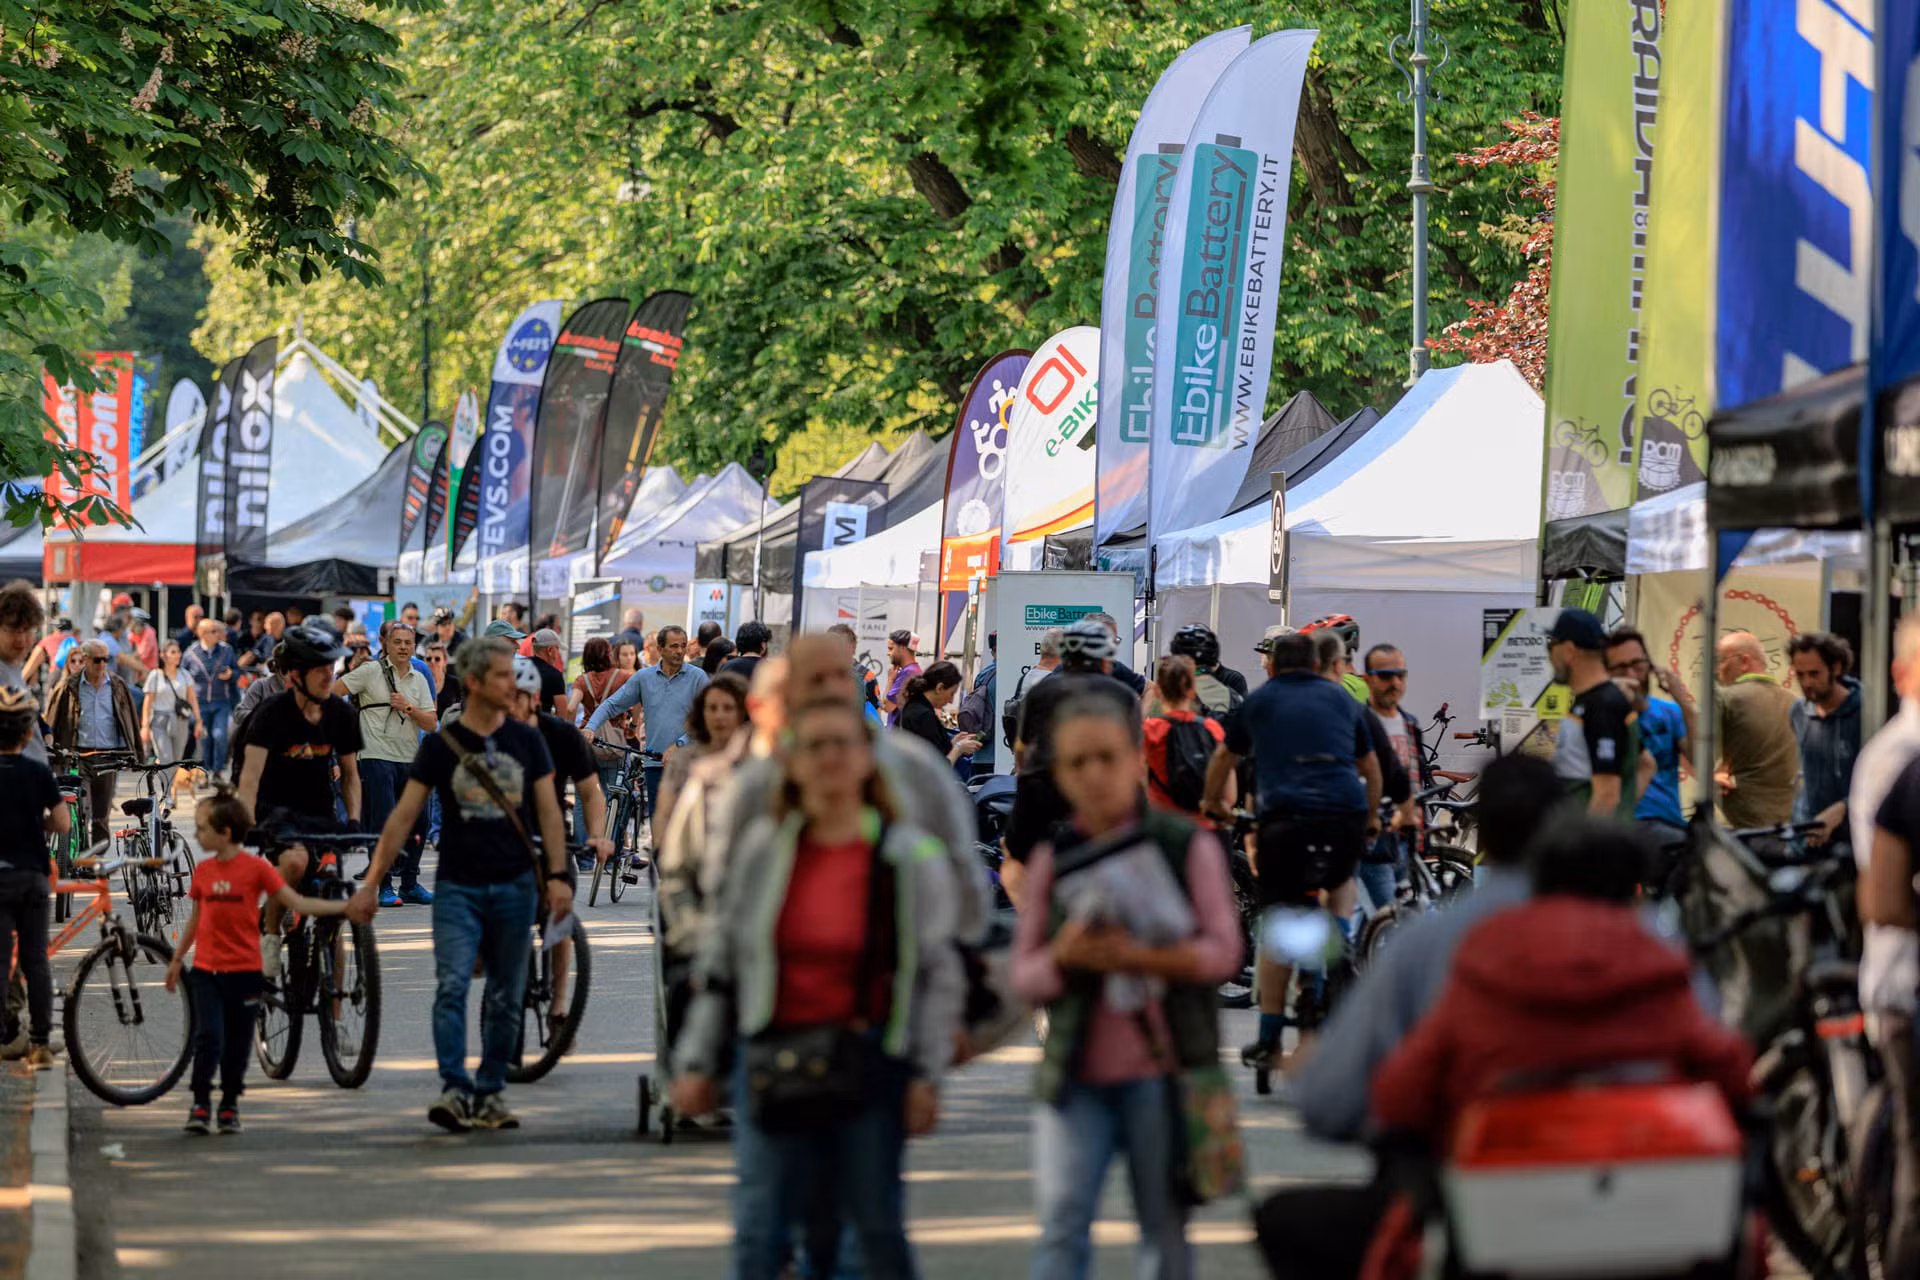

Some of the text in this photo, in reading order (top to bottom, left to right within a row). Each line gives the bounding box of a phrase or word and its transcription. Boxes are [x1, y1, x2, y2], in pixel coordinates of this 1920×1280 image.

[1232, 153, 1279, 450] WWW.EBIKEBATTERY.IT
[91, 367, 119, 507] UCAT
[230, 367, 274, 527] nilox
